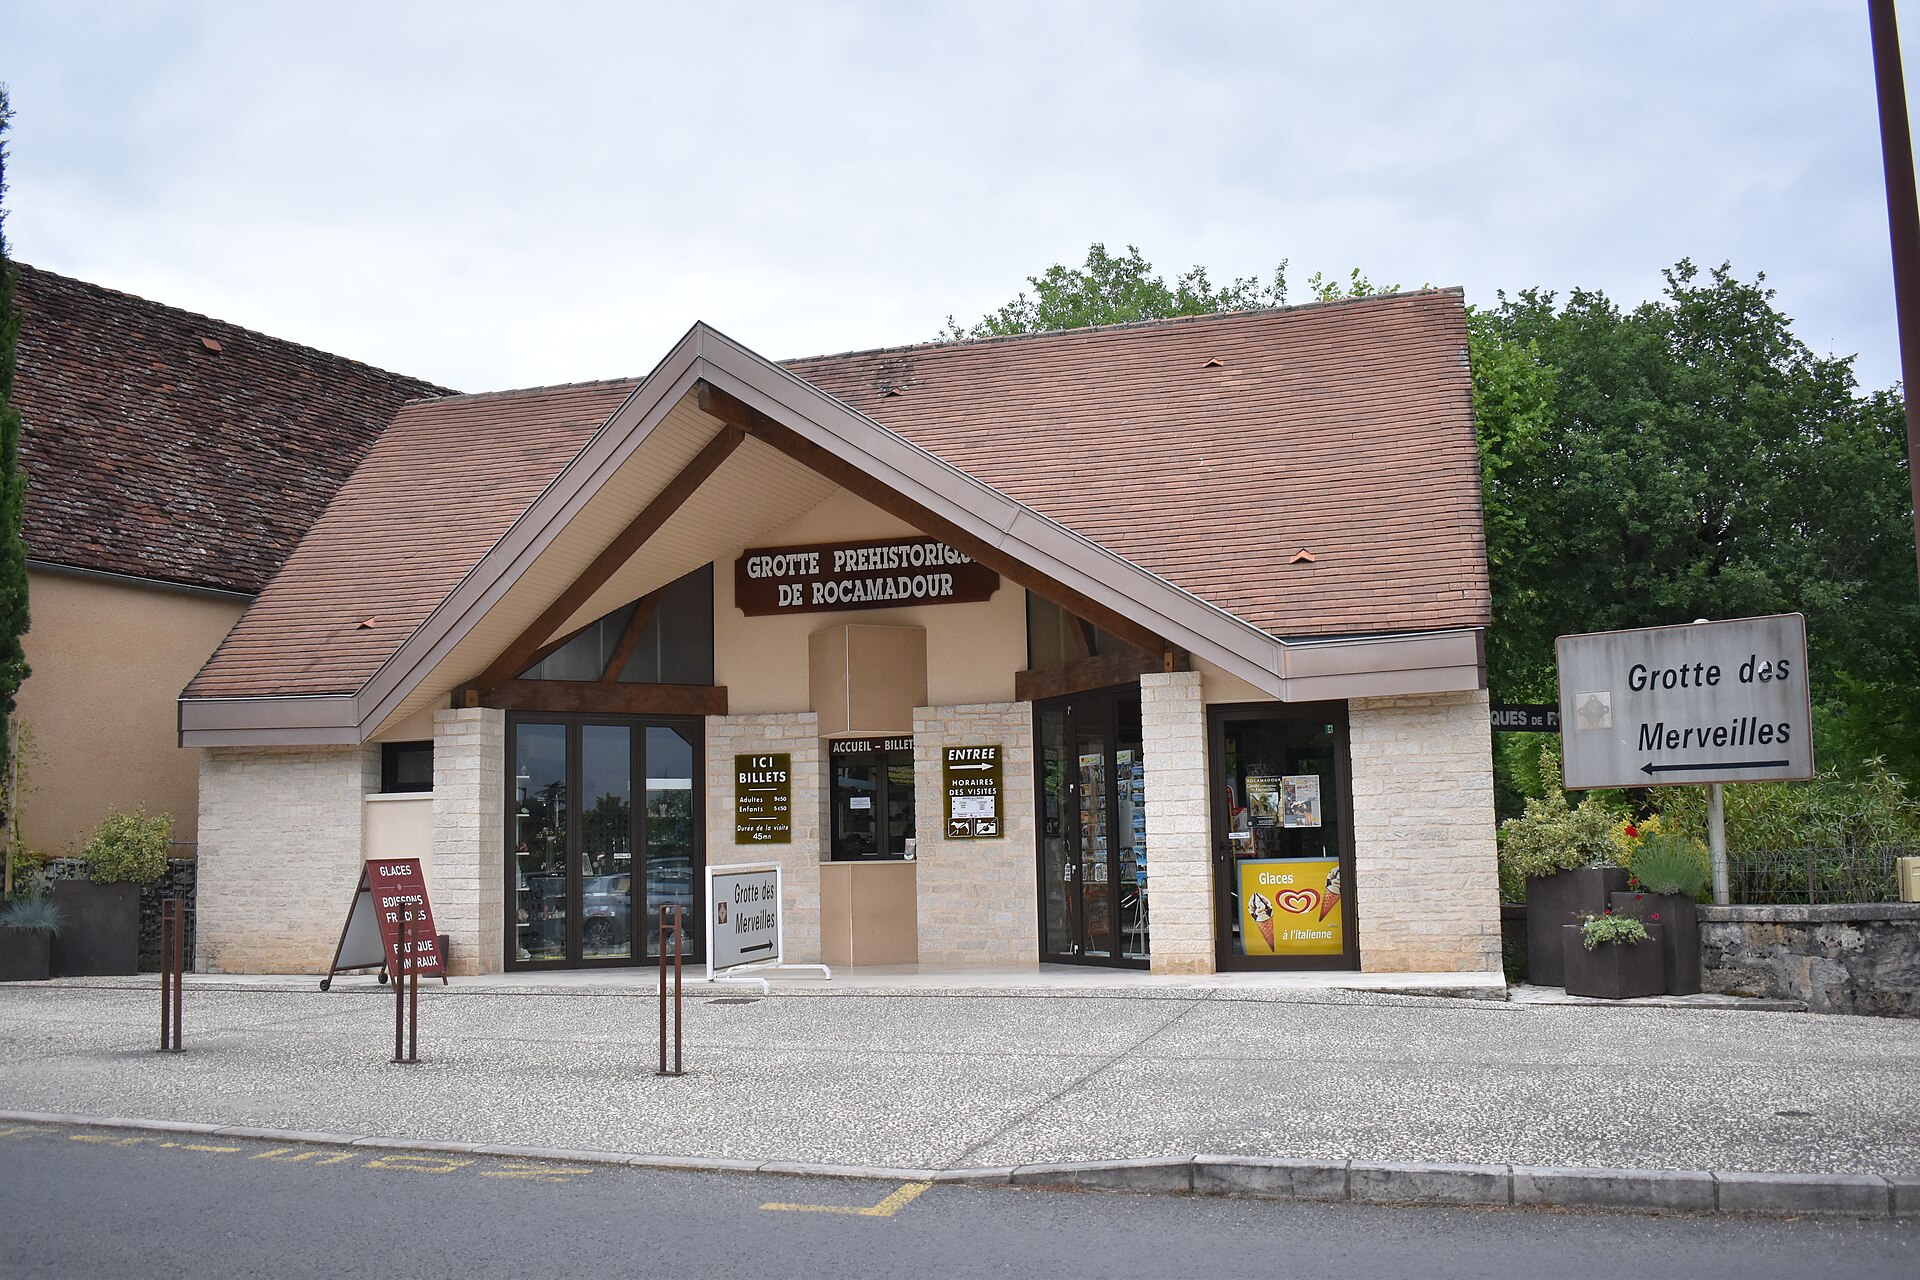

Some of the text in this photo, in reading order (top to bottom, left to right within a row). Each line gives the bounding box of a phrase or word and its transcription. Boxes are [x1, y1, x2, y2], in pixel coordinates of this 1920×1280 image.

[747, 552, 820, 579] GROTTE
[778, 574, 953, 607] DE ROCAMADOUR
[1628, 654, 1790, 692] Grotte des
[1531, 716, 1543, 726] DE
[1638, 716, 1791, 751] Merveilles
[833, 741, 872, 753] ACCUEIL
[948, 748, 995, 761] ENTREE
[752, 756, 773, 768] ICI
[739, 771, 786, 783] BILLETS
[952, 778, 993, 786] HORAIRES
[949, 787, 997, 796] DES VISITES
[756, 824, 763, 832] de
[773, 823, 789, 831] visite
[379, 865, 412, 877] GLACES
[1259, 872, 1294, 885] Glaces
[734, 880, 775, 904] Grotte des
[735, 909, 775, 934] Merveilles
[1282, 929, 1332, 940] à l'italienne
